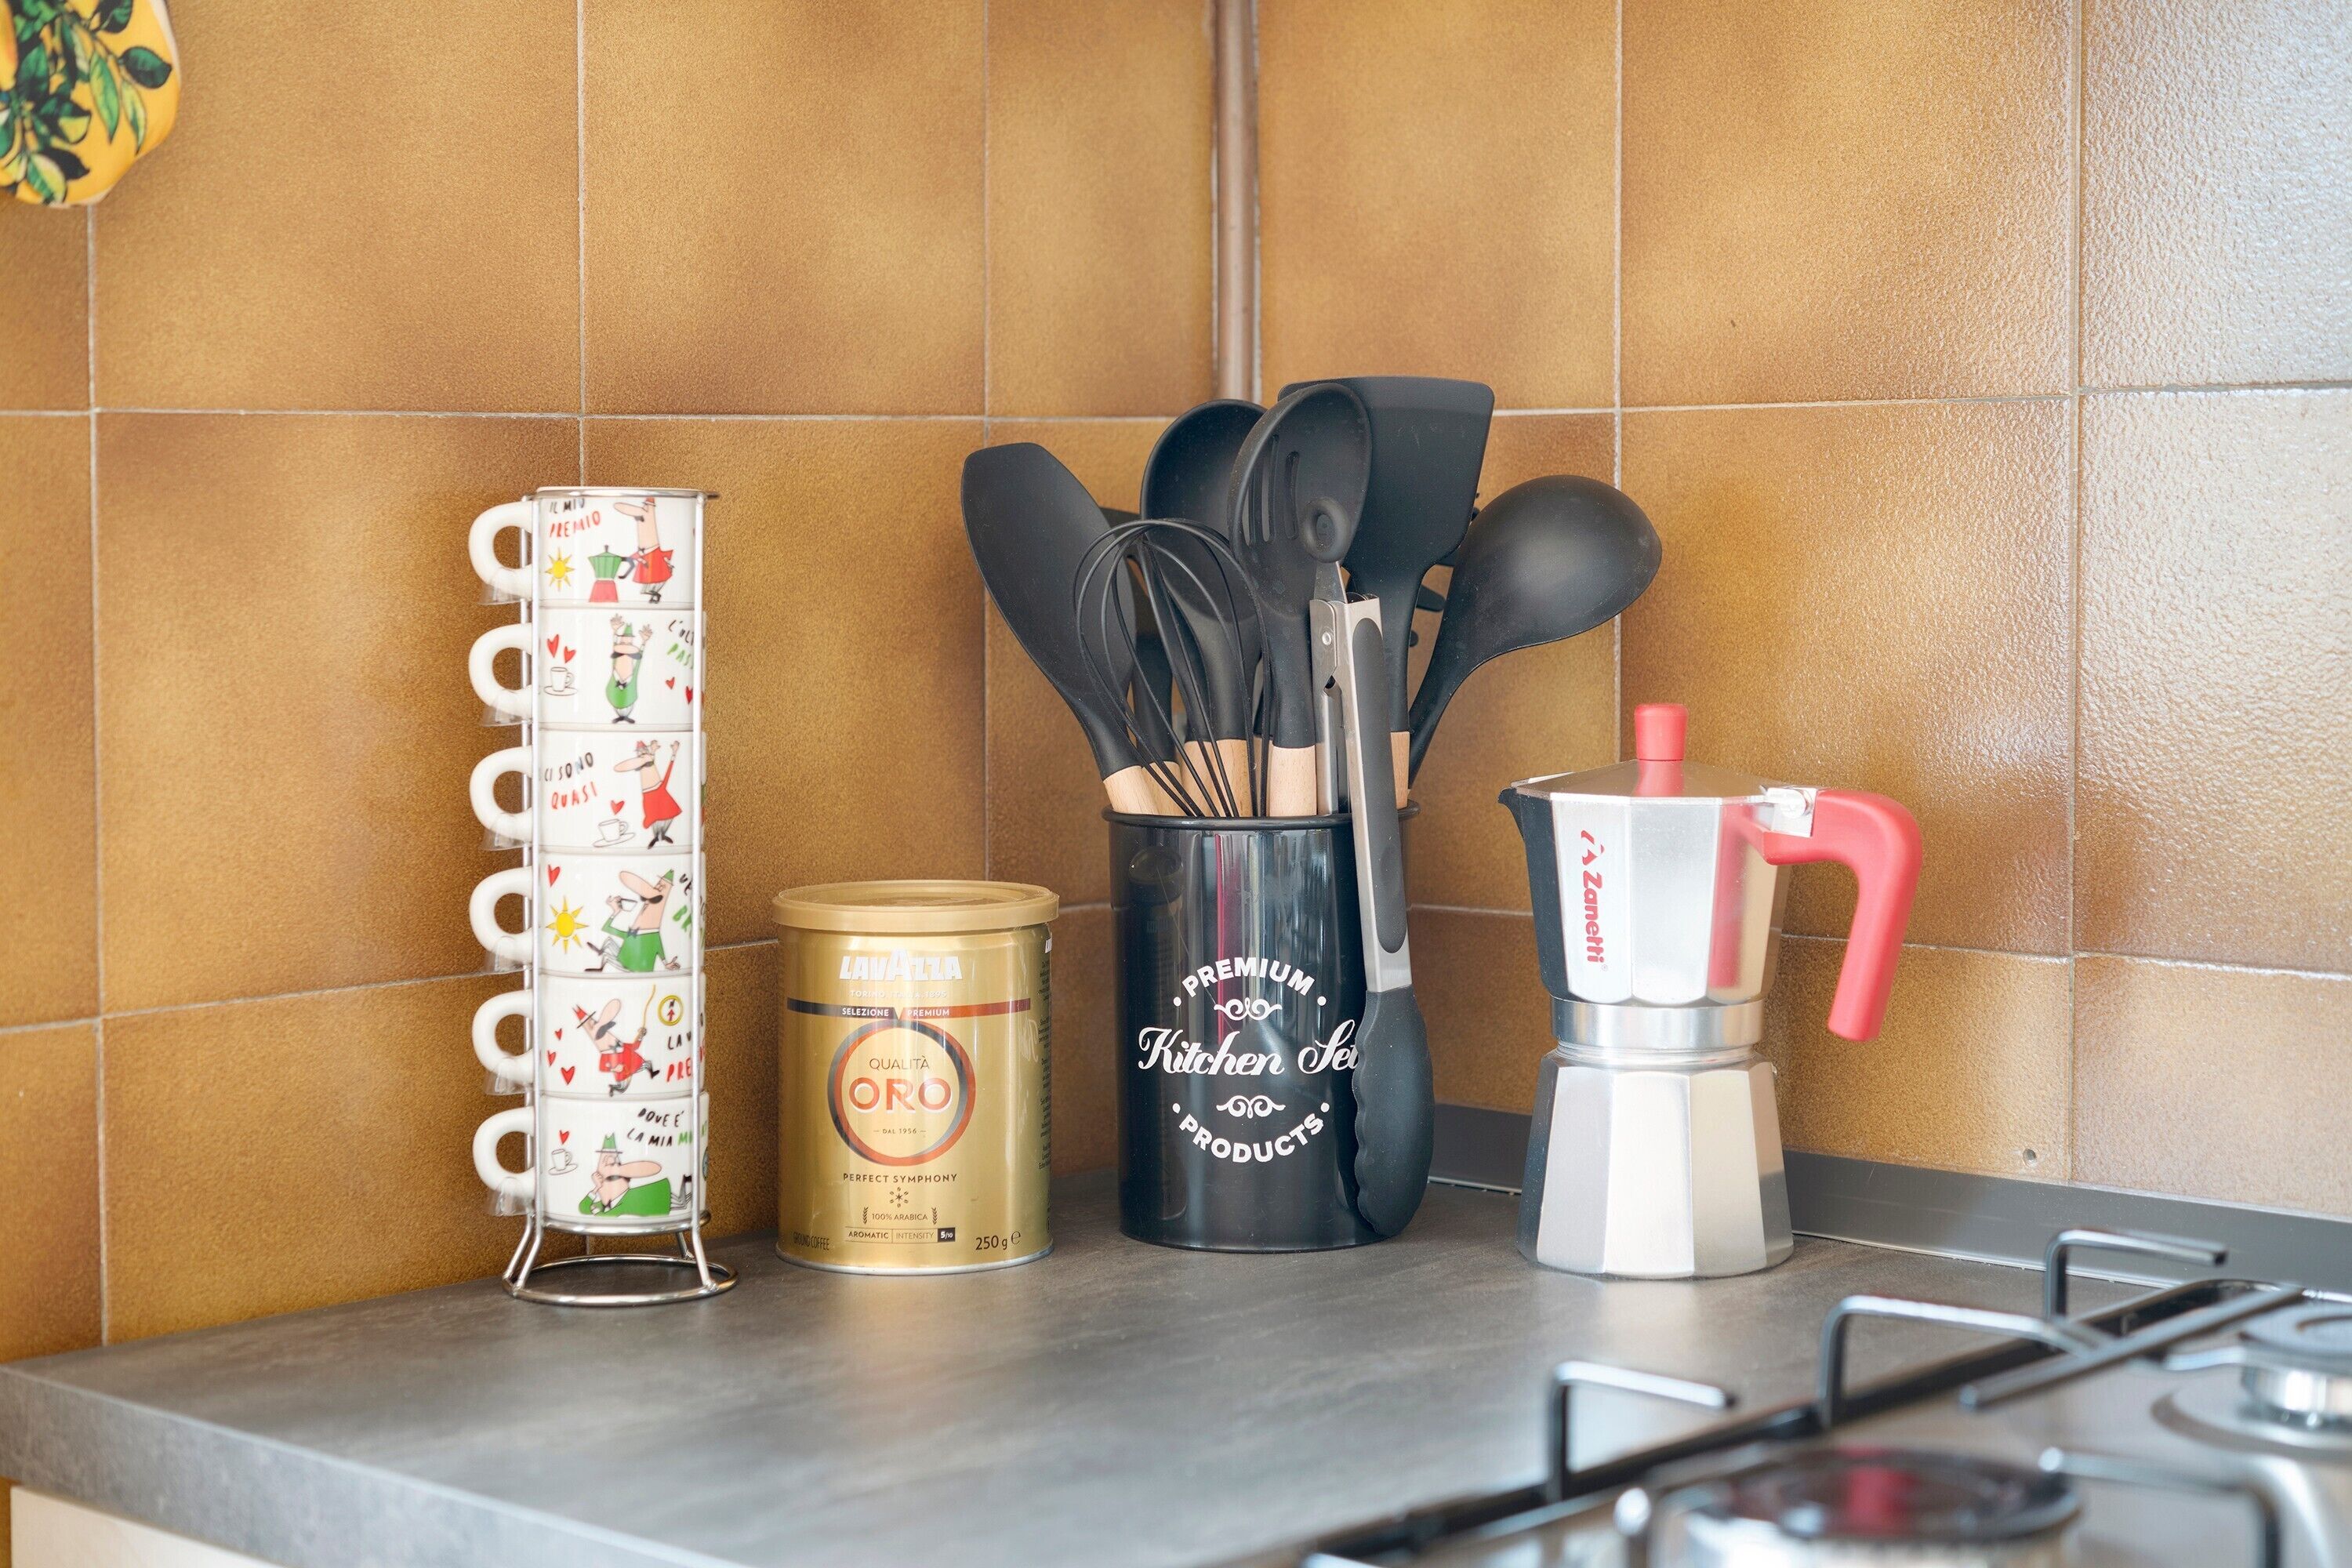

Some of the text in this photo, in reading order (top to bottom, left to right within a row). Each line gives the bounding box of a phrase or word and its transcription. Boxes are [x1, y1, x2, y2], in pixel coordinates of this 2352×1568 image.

[550, 501, 558, 514] IL
[550, 510, 601, 538] PREMIO
[558, 752, 593, 781] SONO
[551, 781, 597, 810] QUASI
[1583, 870, 1605, 963] Zanetti
[839, 948, 964, 982] LAVAZZA
[1181, 956, 1316, 997] PREMIUM
[841, 1007, 950, 1017] SELEZIONE PREMIUM
[1138, 1018, 1359, 1076] Kitchen Set
[666, 1057, 693, 1083] PRE
[869, 1054, 931, 1071] QUALITÀ
[848, 1076, 953, 1113] ORO
[627, 1127, 644, 1142] LA
[648, 1135, 673, 1147] MIA
[1179, 1112, 1325, 1163] PRODUCTS
[843, 1172, 958, 1184] PERFECT SYMPHONY
[811, 1236, 830, 1251] COFFEE
[848, 1231, 890, 1240] AROMATIC
[895, 1232, 935, 1240] INTENSITY
[975, 1235, 1000, 1251] 250
